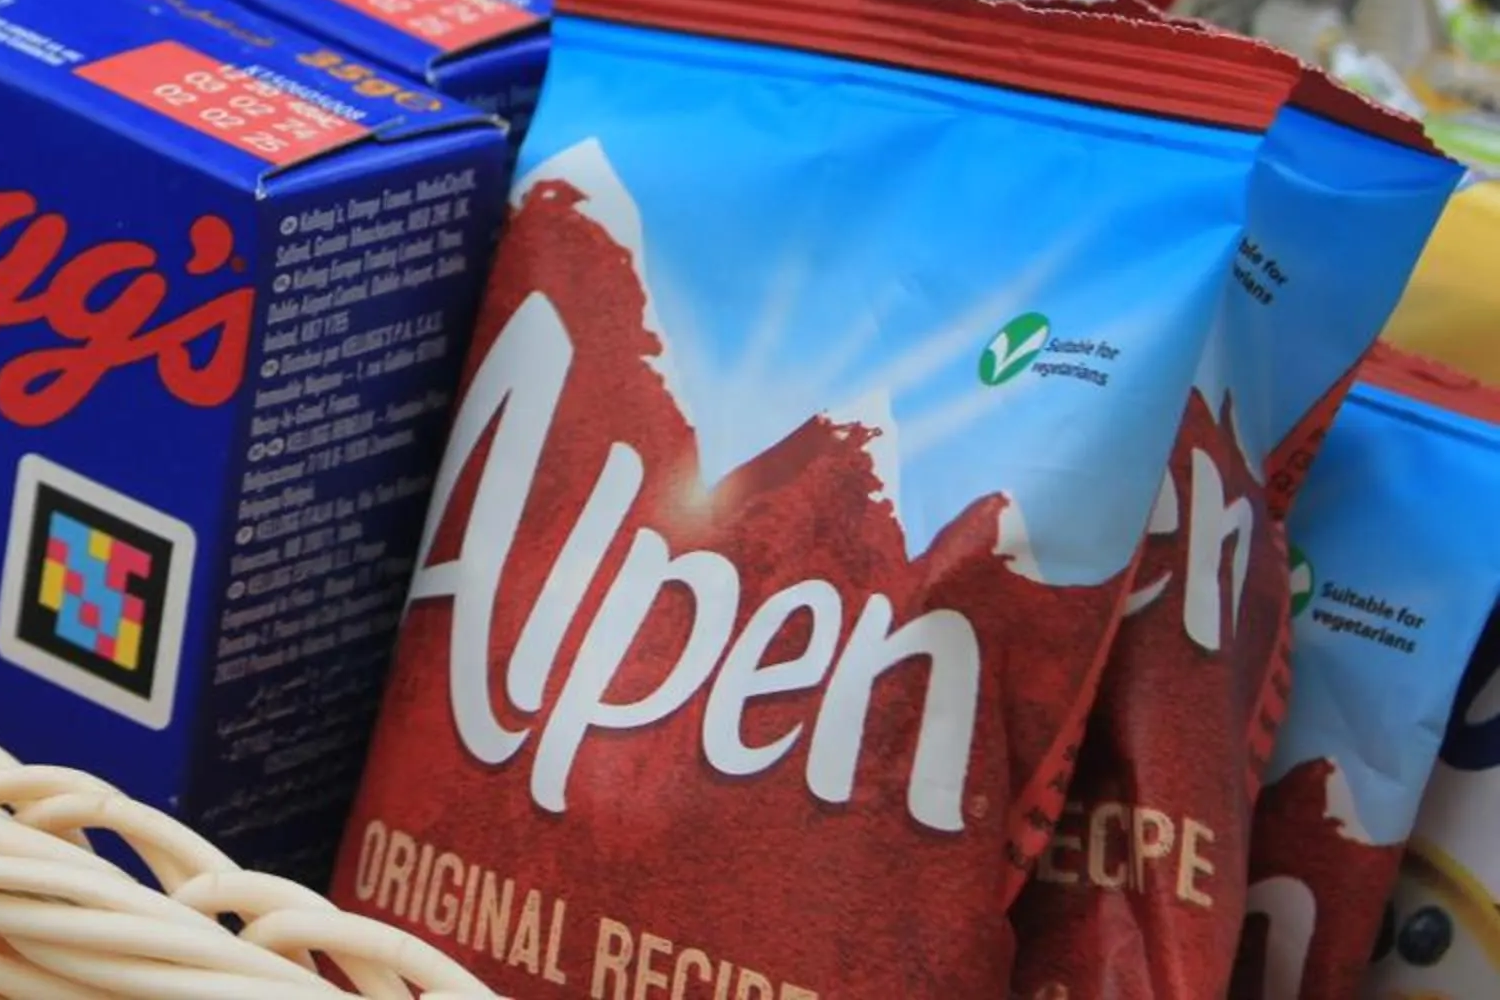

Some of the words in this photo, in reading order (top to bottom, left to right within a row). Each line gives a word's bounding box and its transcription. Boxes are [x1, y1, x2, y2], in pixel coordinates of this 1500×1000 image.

[405, 289, 981, 832] Alpen
[1320, 580, 1394, 620] Suitable
[1396, 606, 1426, 630] for
[1311, 607, 1417, 654] vegetarians
[355, 819, 566, 986] ORIGINAL
